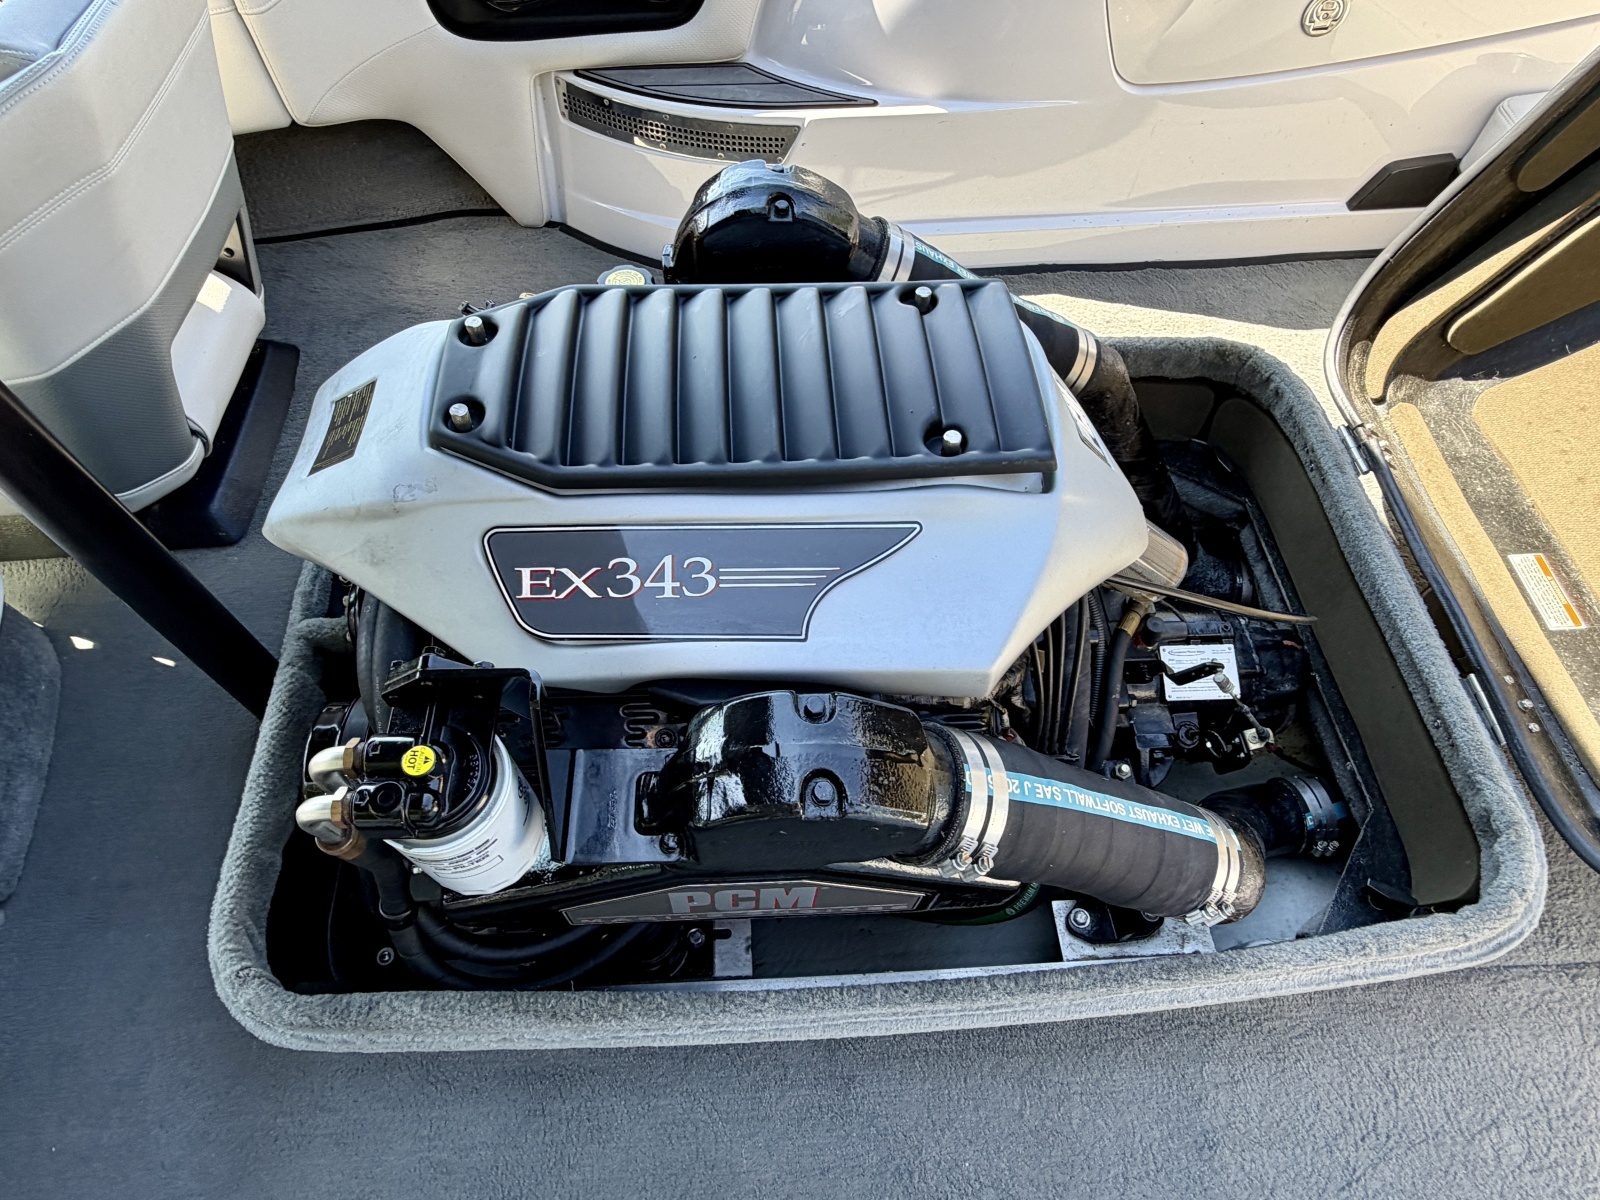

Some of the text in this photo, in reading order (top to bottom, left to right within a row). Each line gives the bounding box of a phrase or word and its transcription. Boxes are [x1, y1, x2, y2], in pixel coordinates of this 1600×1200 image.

[406, 750, 420, 770] HOT
[1023, 780, 1031, 796] J
[1033, 782, 1062, 801] SAE
[1063, 788, 1127, 816] SOFTWALL
[1129, 805, 1182, 829] EXHAUST
[1182, 819, 1206, 835] WET
[668, 886, 819, 914] PCM
